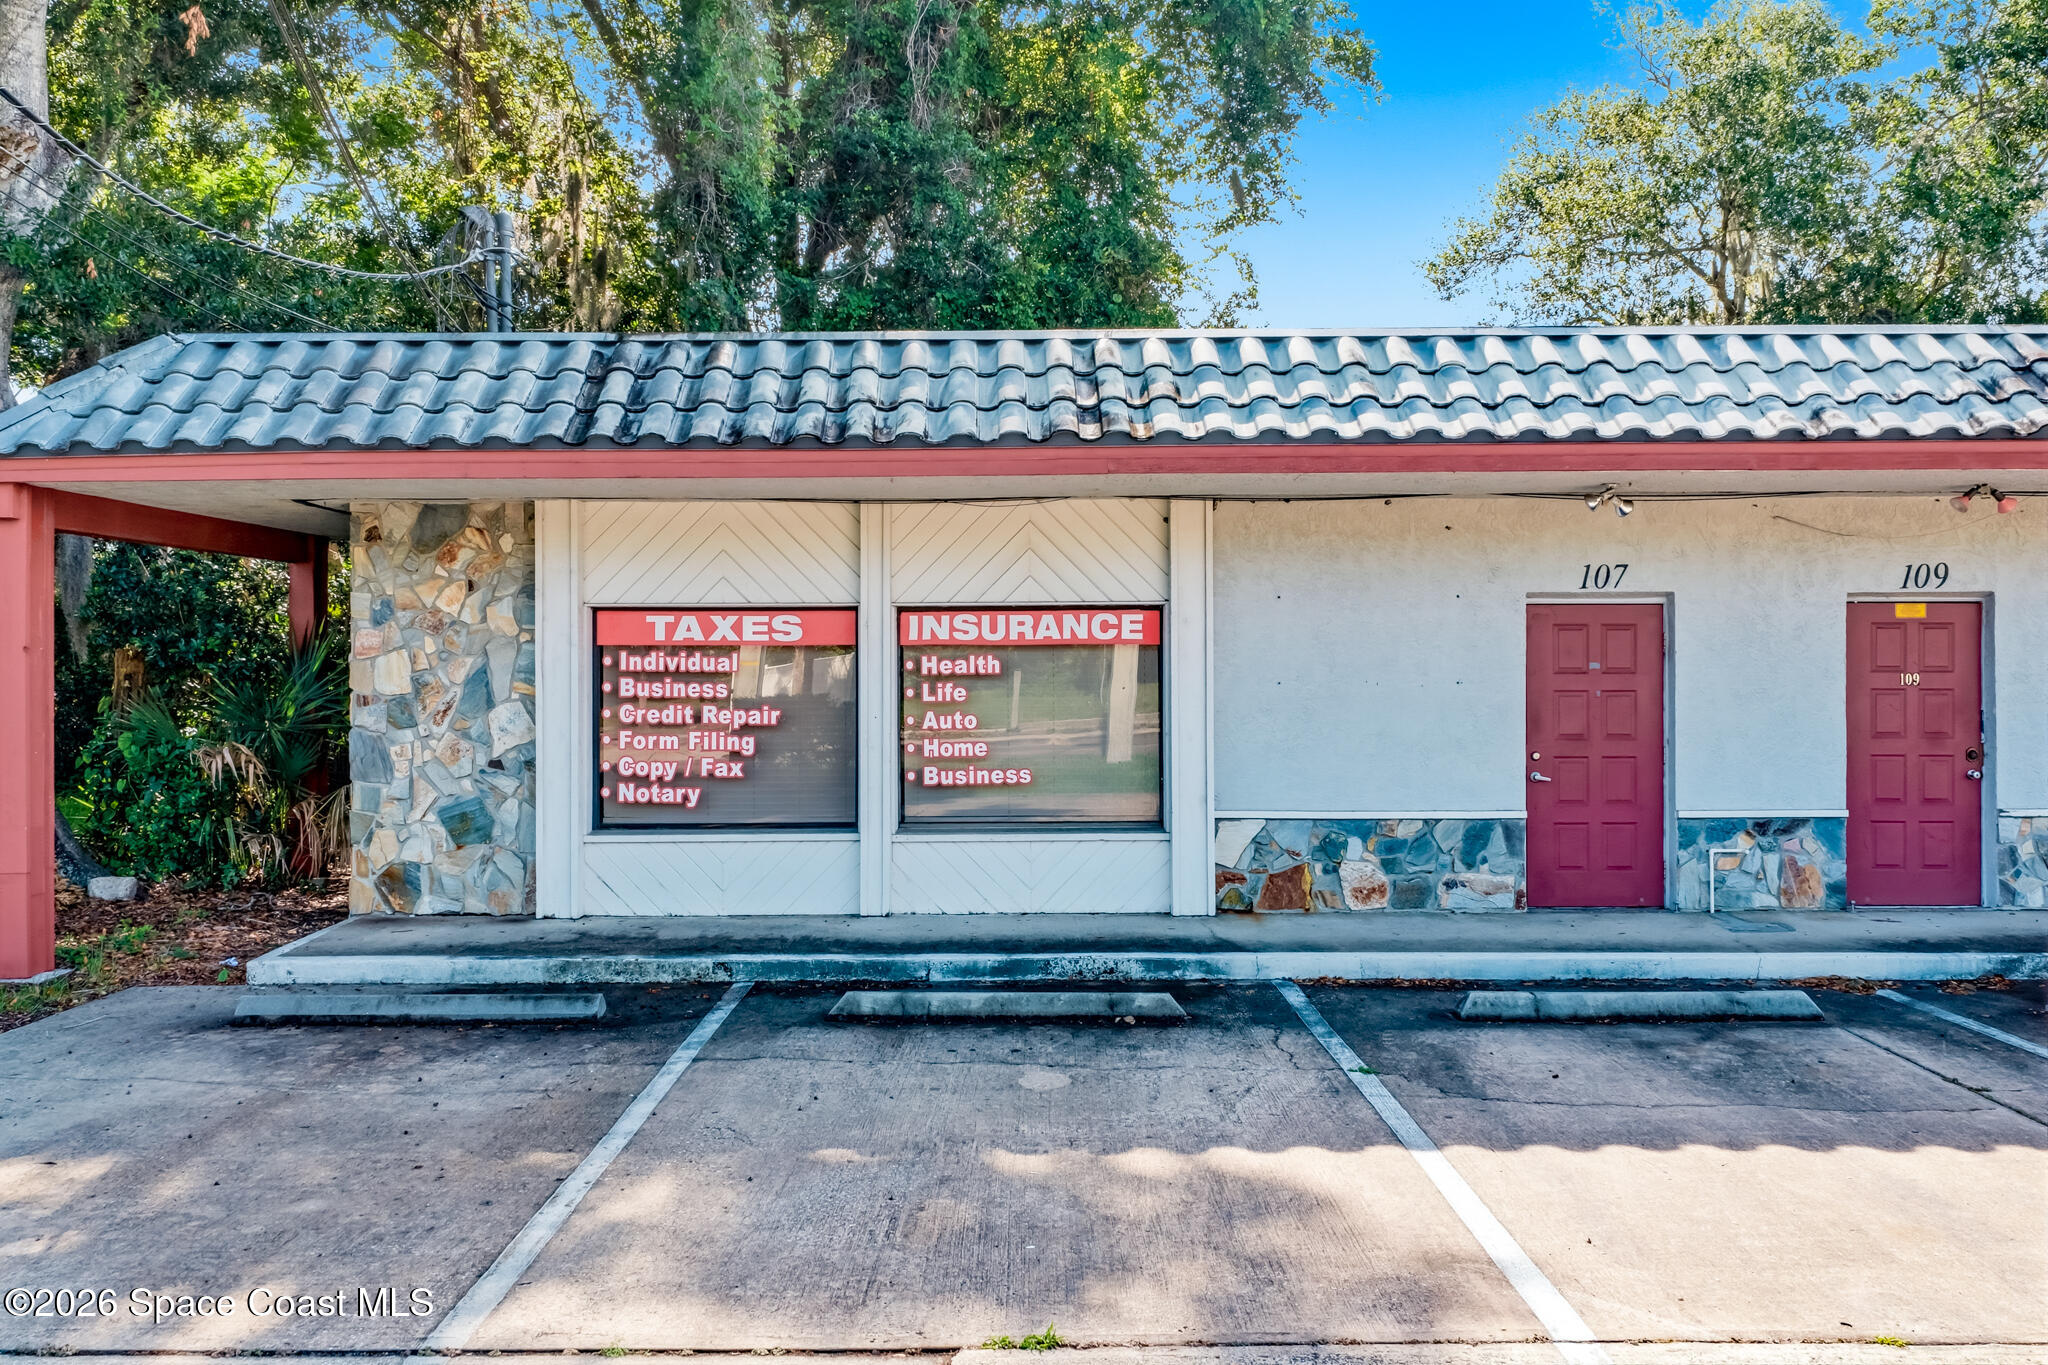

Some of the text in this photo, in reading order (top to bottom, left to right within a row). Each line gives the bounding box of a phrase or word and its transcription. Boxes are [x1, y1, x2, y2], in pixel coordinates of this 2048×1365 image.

[1578, 564, 1628, 589] 107
[1899, 562, 1949, 589] 109
[646, 615, 803, 641] TAXES
[908, 613, 1144, 641] INSURANCE
[619, 651, 739, 672] Individual
[920, 655, 1001, 675] Health
[618, 678, 729, 699] Business
[1900, 673, 1920, 686] 109
[921, 682, 968, 702] Life
[618, 704, 781, 729] Credit Repair
[922, 710, 977, 730] Auto
[618, 730, 756, 755] Form Filing
[923, 738, 988, 758] Home
[617, 756, 744, 781] Copy / Fax
[923, 766, 1032, 785] Business
[617, 783, 701, 807] Notary
